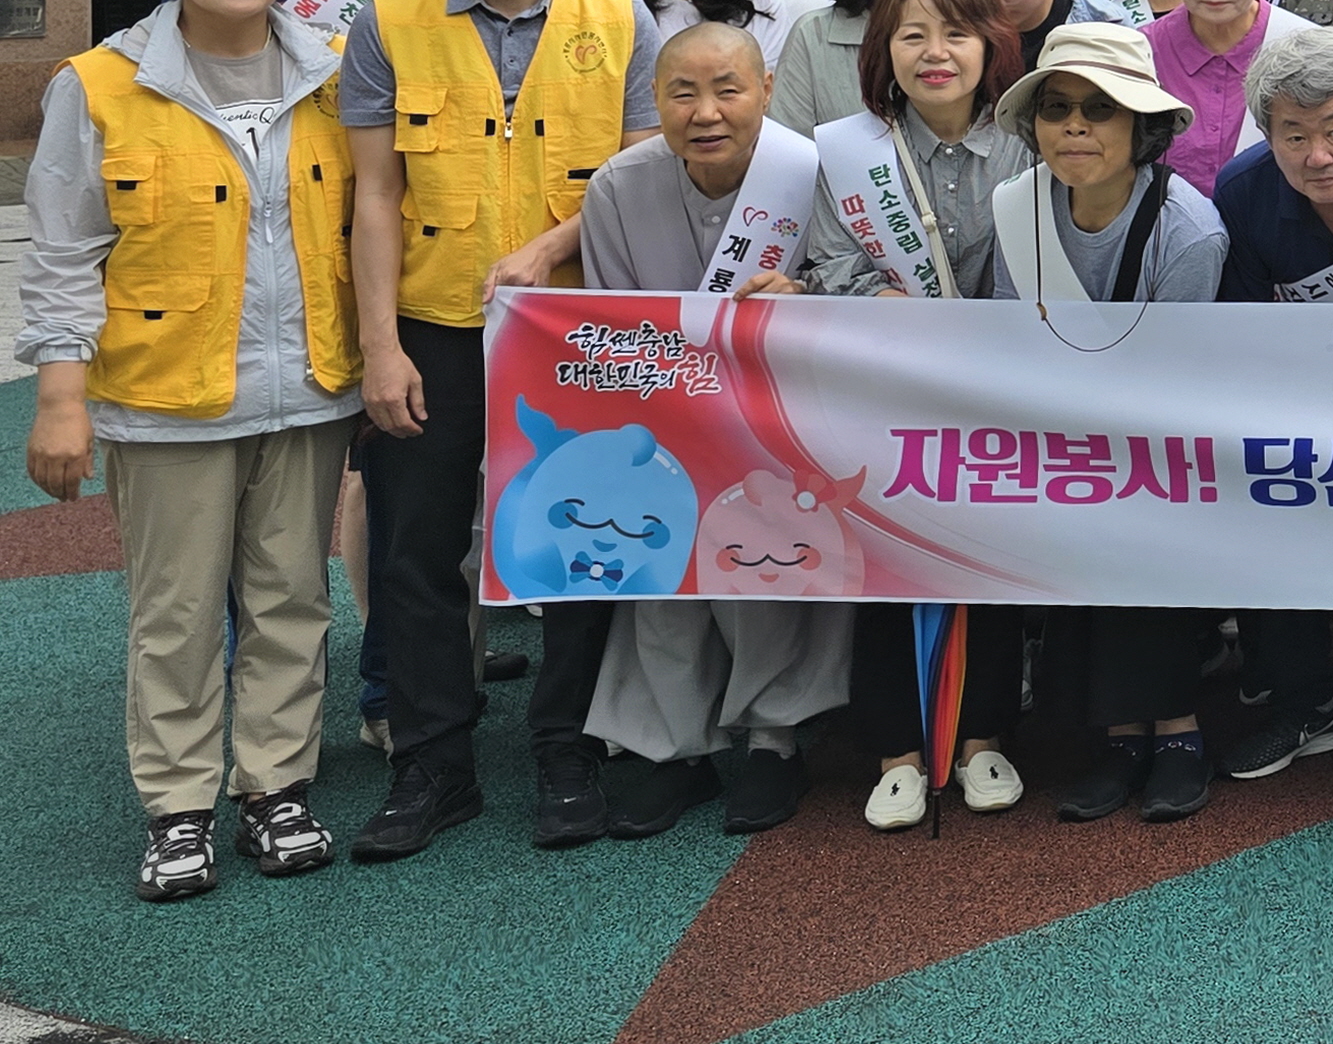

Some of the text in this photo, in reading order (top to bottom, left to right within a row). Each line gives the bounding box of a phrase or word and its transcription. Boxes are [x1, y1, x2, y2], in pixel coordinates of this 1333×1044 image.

[841, 193, 887, 261] 따뜻한
[868, 163, 924, 254] 탄소중립
[558, 354, 720, 398] 대한민국의 힘
[883, 427, 1218, 506] 자원봉사!
